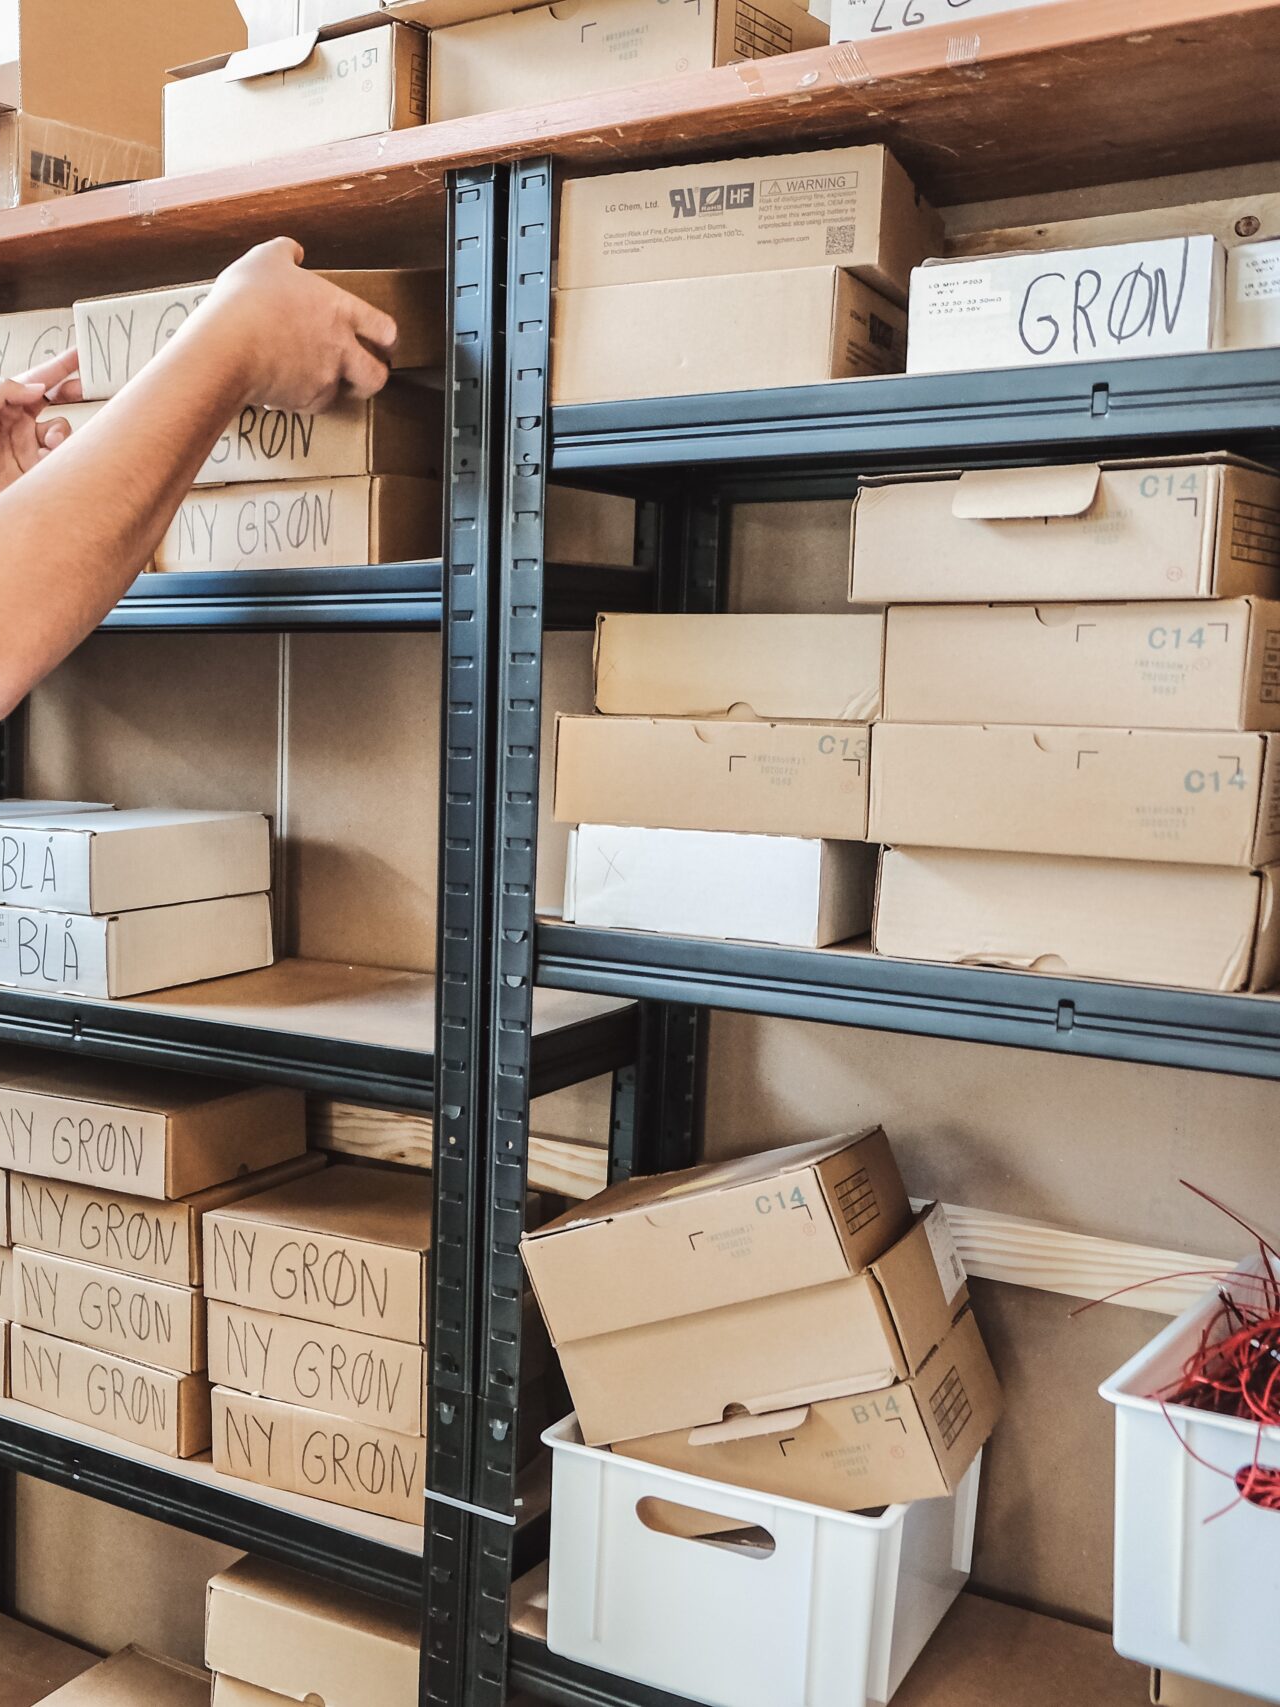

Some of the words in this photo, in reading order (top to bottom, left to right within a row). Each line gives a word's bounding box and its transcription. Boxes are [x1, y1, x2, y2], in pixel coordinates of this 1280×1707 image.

[337, 50, 373, 79] C13
[729, 187, 751, 205] HF
[786, 175, 846, 192] WARNING
[605, 203, 616, 213] LG
[618, 201, 643, 213] Chem,
[645, 199, 660, 209] Ltd.
[763, 214, 774, 222] you
[801, 209, 826, 217] warning
[827, 207, 849, 216] battery
[783, 202, 812, 210] consumer
[823, 215, 856, 224] immediately
[703, 231, 723, 240] Above
[757, 235, 810, 245] www.lgchem.com
[1019, 236, 1189, 355] GRØN
[86, 309, 135, 385] NY
[1139, 472, 1198, 498] C14
[177, 503, 219, 563] NY
[236, 489, 334, 555] GRØN
[1147, 626, 1206, 650] C14
[818, 734, 868, 759] C13
[1183, 767, 1248, 793] C14
[1, 835, 58, 893] BLÅ
[17, 917, 79, 983] BLÅ
[52, 1116, 143, 1176] GRØN
[754, 1185, 806, 1215] C14
[20, 1180, 69, 1249] NY
[79, 1201, 177, 1266] GRØN
[213, 1223, 256, 1294] NY
[270, 1241, 387, 1319] GRØN
[20, 1261, 58, 1327] NY
[78, 1281, 172, 1344] GRØN
[226, 1315, 272, 1390] NY
[293, 1340, 403, 1414] GRØN
[22, 1340, 62, 1399] NY
[86, 1363, 167, 1432] GRØN
[851, 1394, 902, 1425] B14
[225, 1406, 274, 1477] NY
[301, 1430, 417, 1498] GRØN
